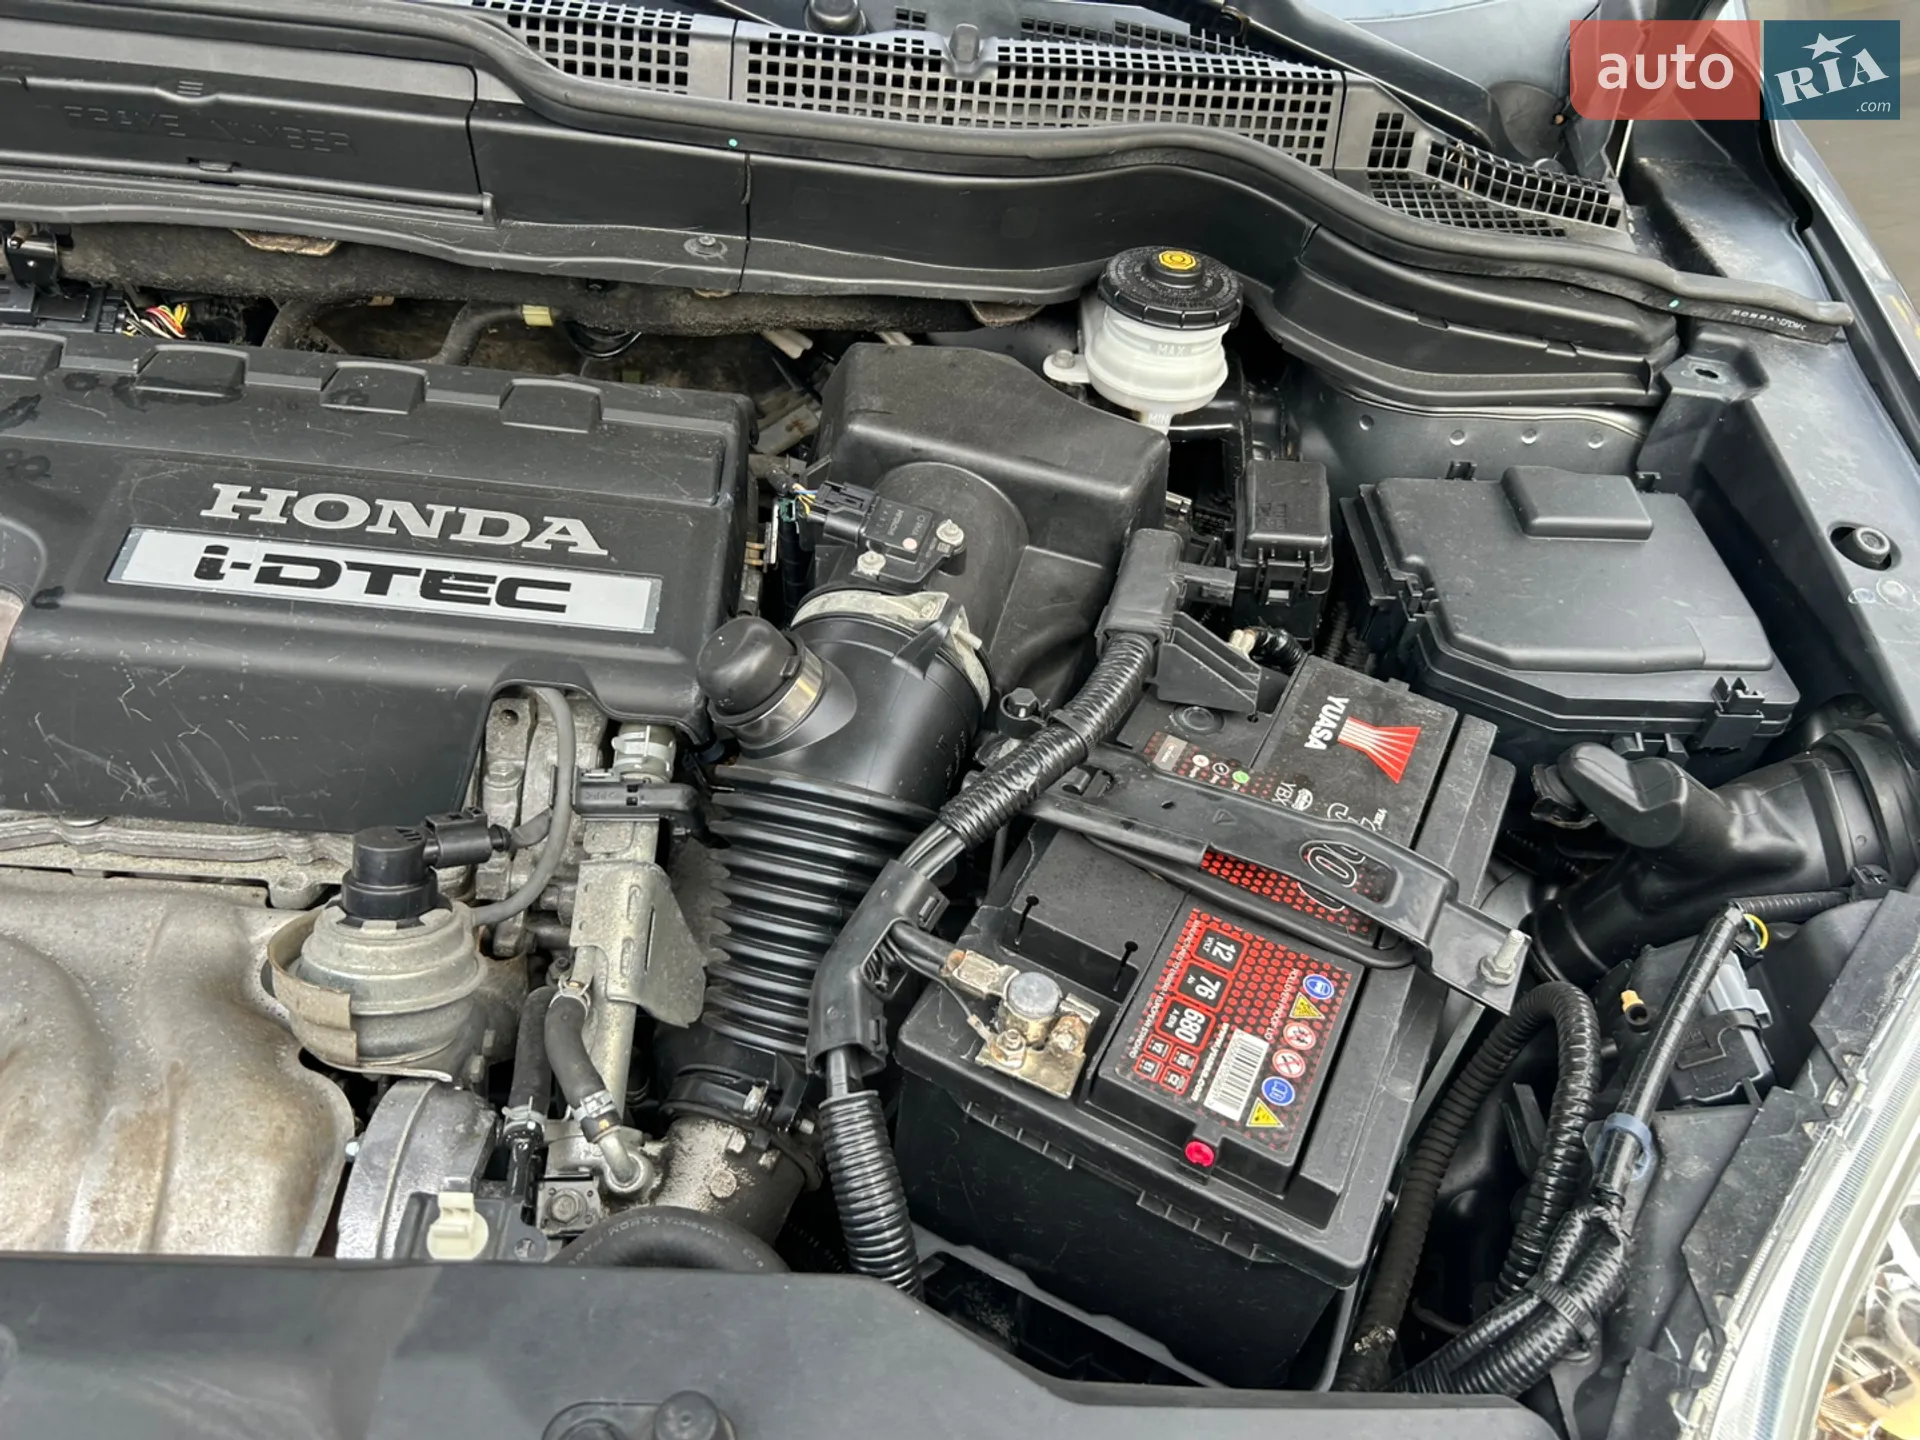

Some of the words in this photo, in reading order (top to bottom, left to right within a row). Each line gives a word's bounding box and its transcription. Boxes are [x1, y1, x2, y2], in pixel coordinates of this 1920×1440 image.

[1157, 343, 1186, 356] MAX
[201, 483, 608, 556] HONDA
[194, 545, 571, 613] i-DTEC
[1303, 695, 1349, 752] YUASA
[1271, 781, 1295, 806] YBX
[1201, 935, 1214, 952] VOLT
[1211, 940, 1236, 962] 12
[1194, 975, 1220, 1000] 76
[1174, 1008, 1205, 1044] 680
[1189, 1021, 1230, 1101] www.yuasa.com
